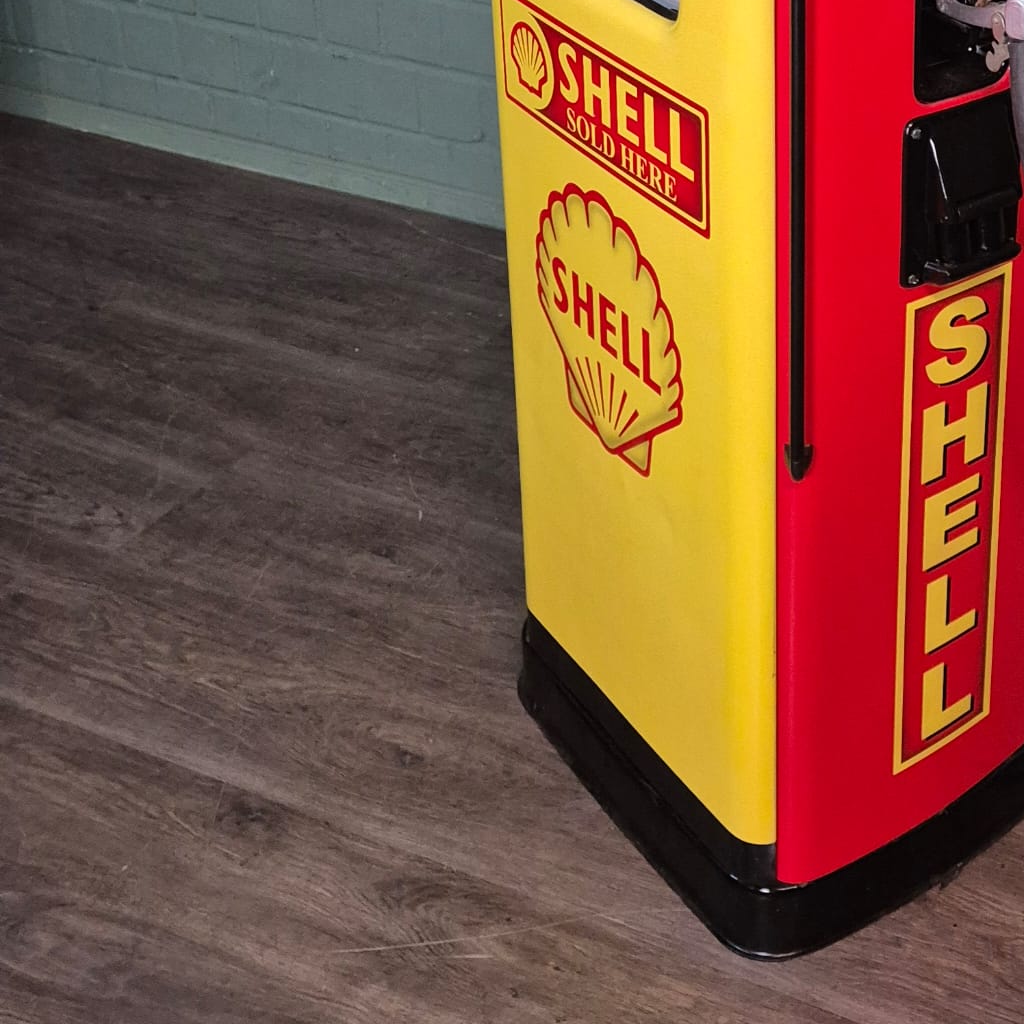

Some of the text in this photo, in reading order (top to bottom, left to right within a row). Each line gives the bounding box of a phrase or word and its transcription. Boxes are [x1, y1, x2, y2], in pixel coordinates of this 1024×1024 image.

[557, 42, 695, 183] SHELL
[566, 107, 678, 203] SOLD HERE
[551, 256, 661, 396] SHELL
[921, 295, 990, 742] SHELL
